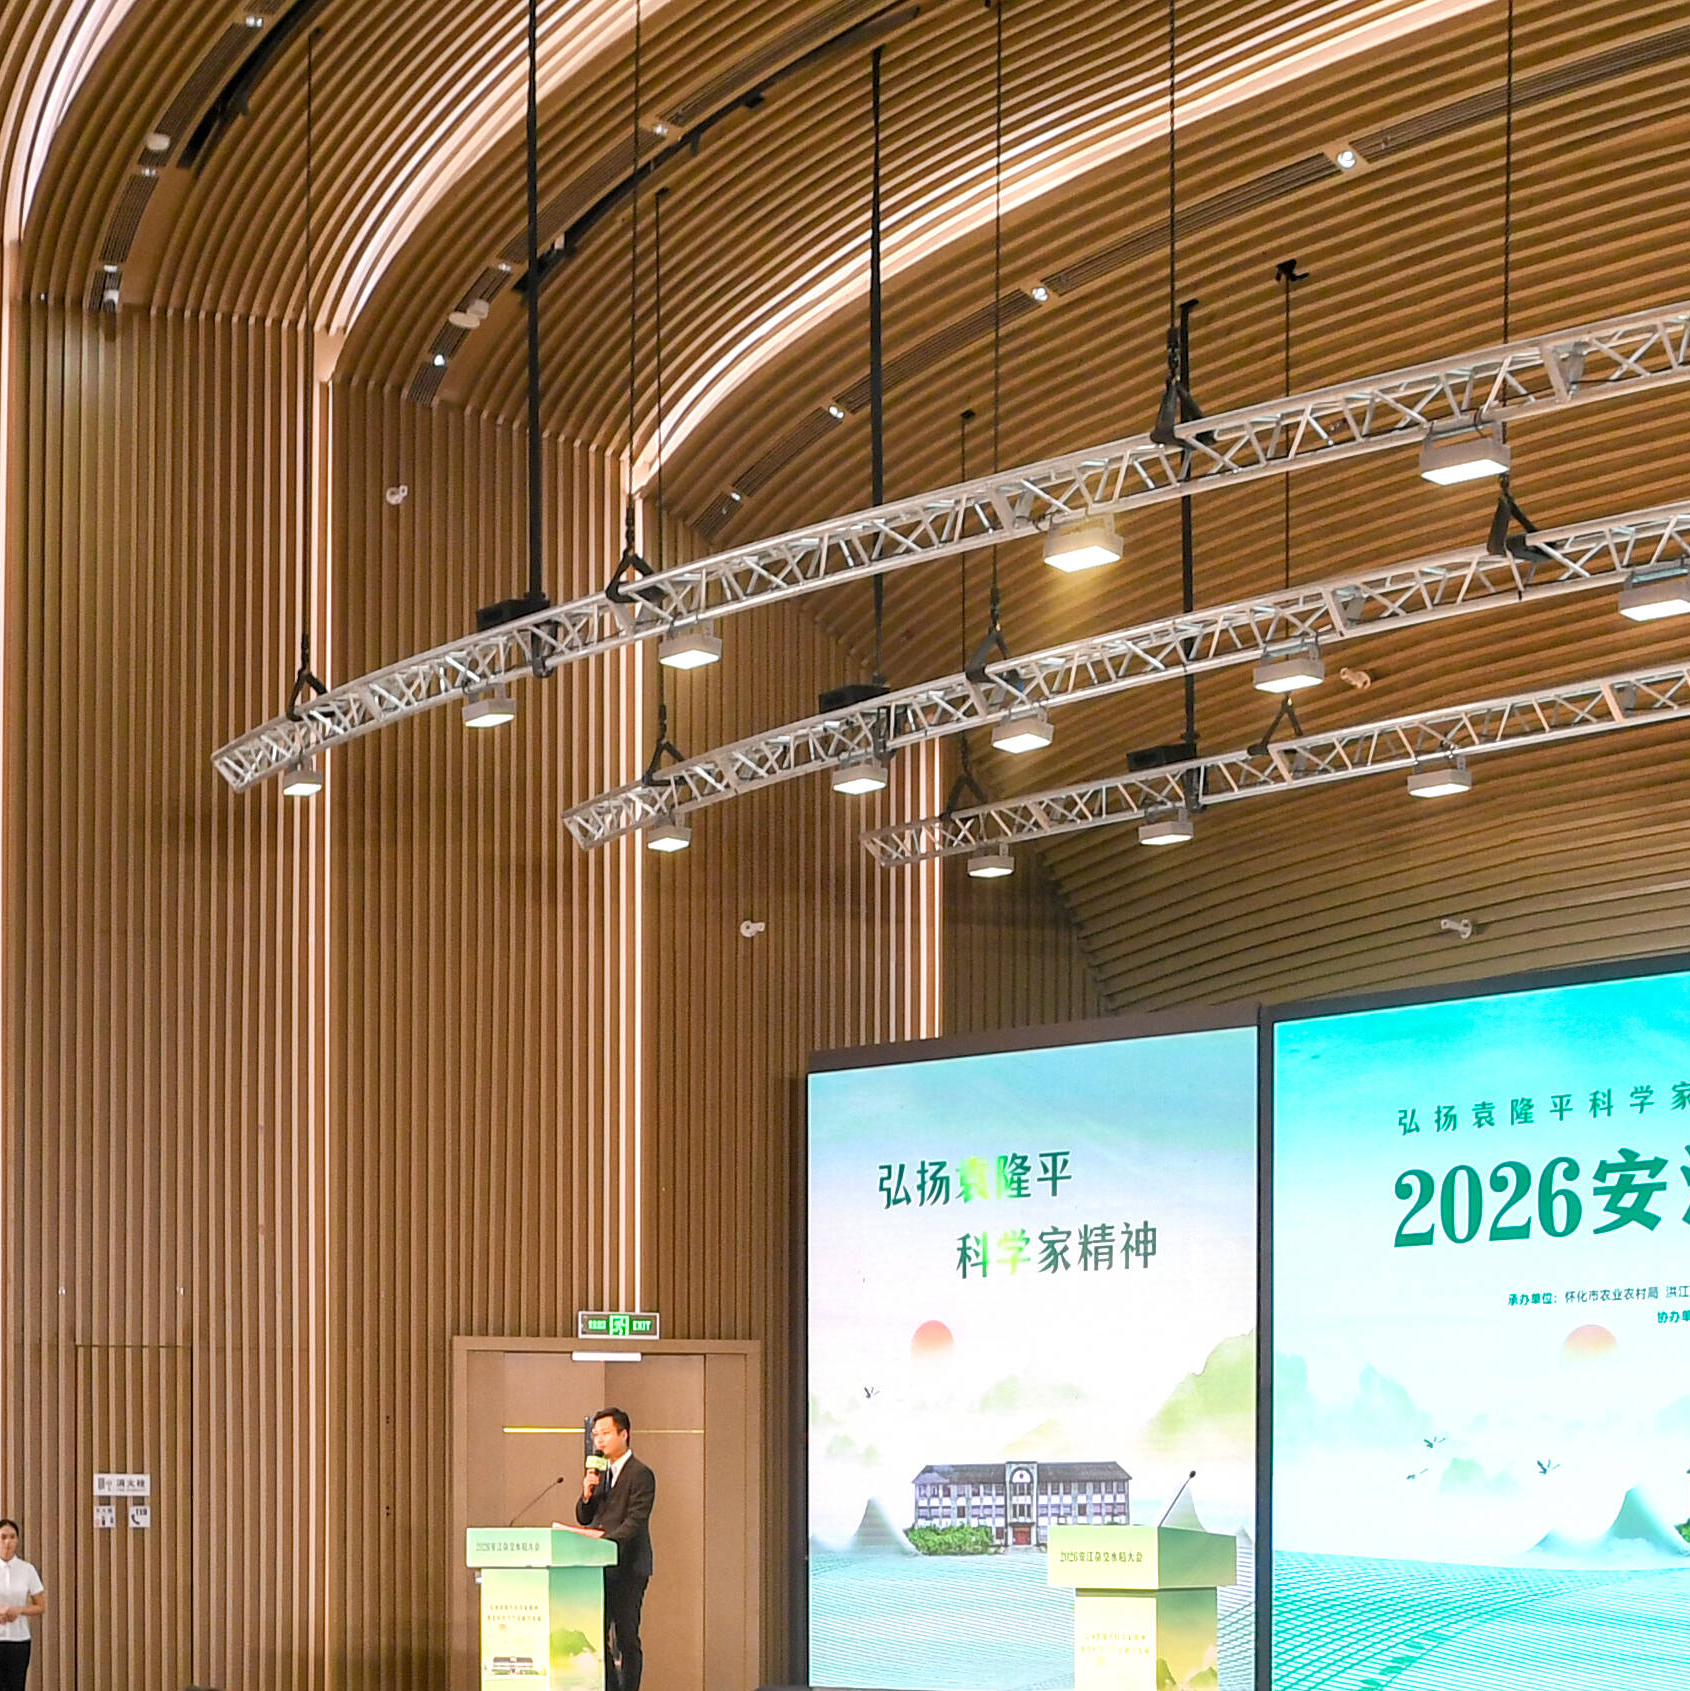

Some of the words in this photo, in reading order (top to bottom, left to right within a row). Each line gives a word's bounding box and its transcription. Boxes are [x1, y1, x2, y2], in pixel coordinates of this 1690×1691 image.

[877, 1150, 1072, 1210] 弘扬袁隆平
[955, 1220, 1158, 1280] 科学家精神
[1564, 1285, 1659, 1304] 怀化市农业农村局
[633, 1320, 652, 1331] EXIT
